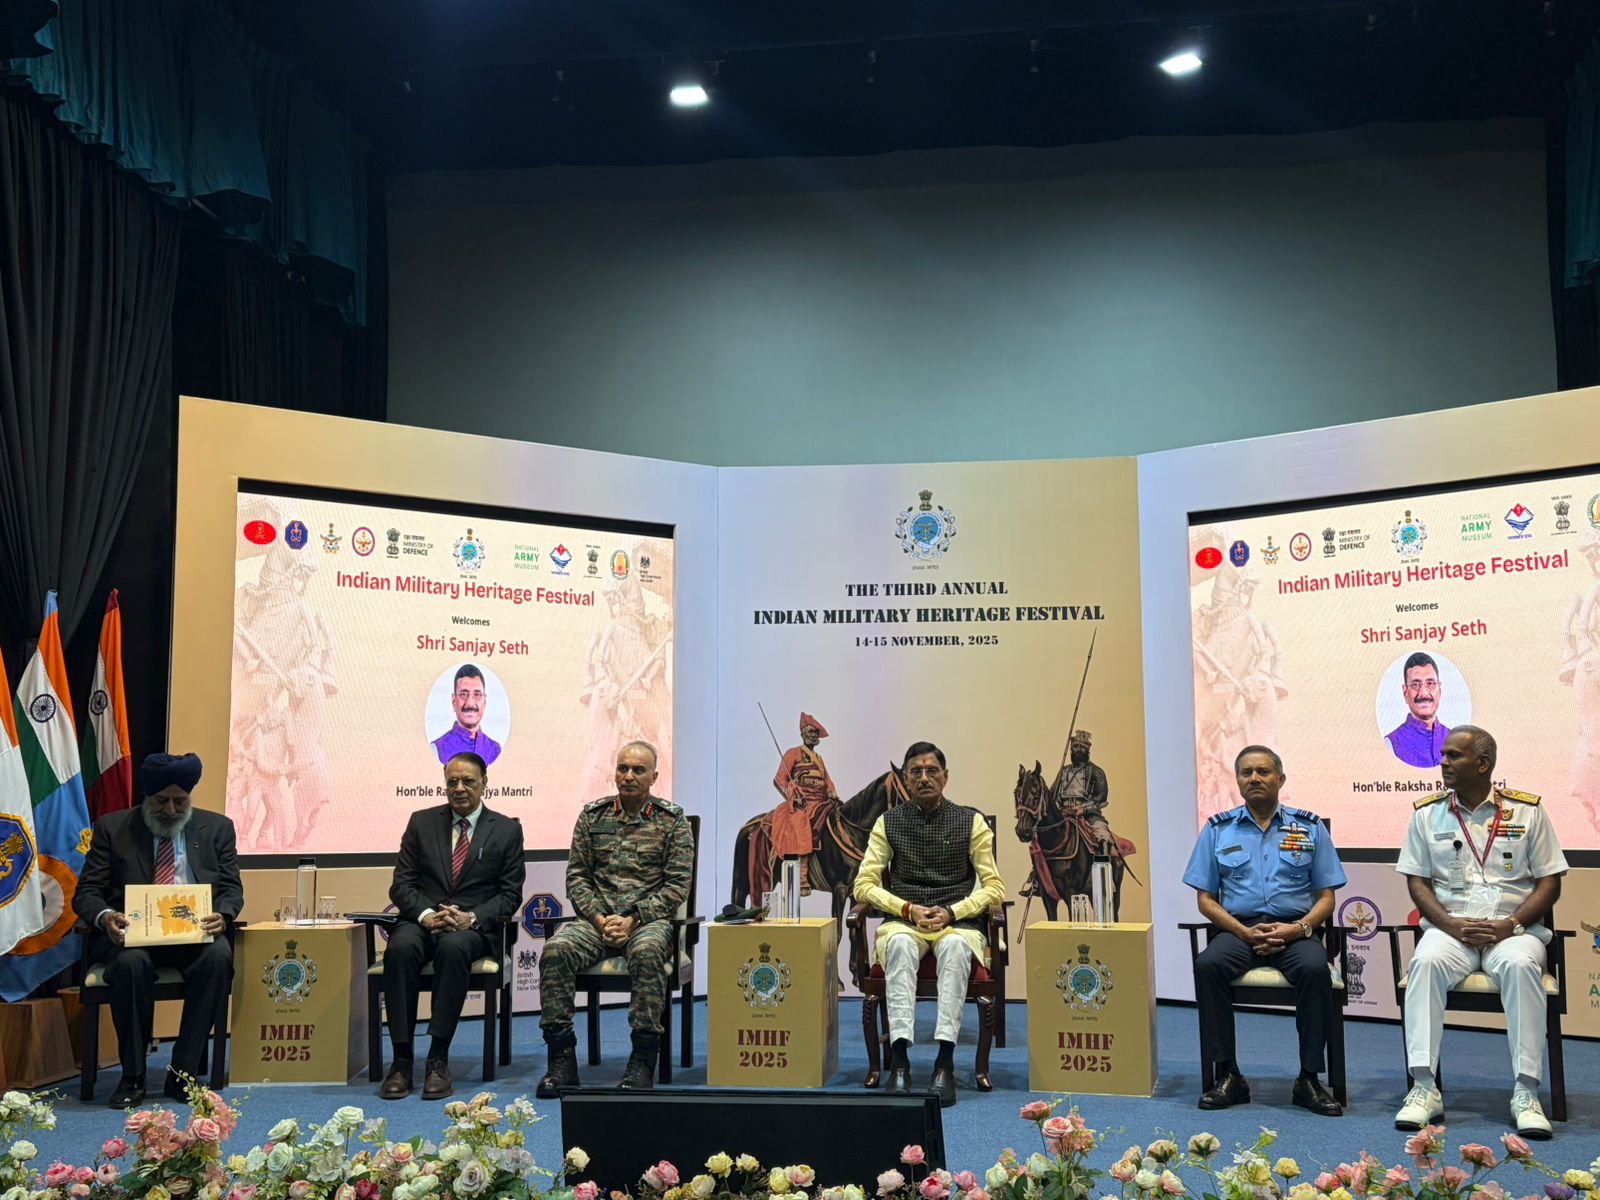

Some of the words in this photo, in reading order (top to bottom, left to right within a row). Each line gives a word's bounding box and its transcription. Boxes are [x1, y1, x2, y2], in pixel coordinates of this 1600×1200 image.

[1461, 520, 1492, 534] ARMY
[1461, 533, 1492, 542] MUSEUM
[403, 547, 428, 556] DEFENCE
[1339, 541, 1365, 551] DEFENCE
[514, 552, 540, 562] ARMY
[1278, 575, 1330, 594] Indian
[1335, 569, 1402, 589] Military
[1406, 561, 1486, 581] Heritage
[1491, 549, 1569, 574] Festival
[336, 570, 391, 591] Indian
[395, 575, 460, 600] Military
[464, 581, 532, 604] Heritage
[536, 587, 595, 607] Festival
[845, 583, 879, 597] THE
[883, 582, 937, 597] THIRD
[941, 581, 1008, 596] ANNUAL
[753, 609, 818, 625] INDIAN
[823, 607, 911, 625] MILITARY
[916, 606, 1010, 623] HERITAGE
[1015, 605, 1105, 621] FESTIVAL
[1395, 601, 1439, 613] Welcomes
[451, 615, 490, 627] Welcomes
[1361, 626, 1390, 643] Shri
[1395, 623, 1446, 643] Sanjay
[1451, 619, 1487, 637] Seth
[416, 634, 445, 650] Shri
[449, 636, 495, 657] Sanjay
[499, 640, 529, 655] Seth
[855, 636, 888, 647] 14-15
[891, 636, 964, 648] NOVEMBER,
[968, 635, 999, 646] 2025
[396, 786, 434, 797] Hon'ble
[501, 785, 532, 797] Mantri
[1353, 781, 1392, 793] Hon'ble
[1394, 780, 1433, 792] Raksha
[260, 1024, 315, 1041] IMHF
[737, 1029, 791, 1047] IMHF
[1057, 1031, 1114, 1050] IMHF
[261, 1045, 311, 1062] 2025
[739, 1050, 788, 1069] 2025
[1060, 1054, 1112, 1073] 2025
